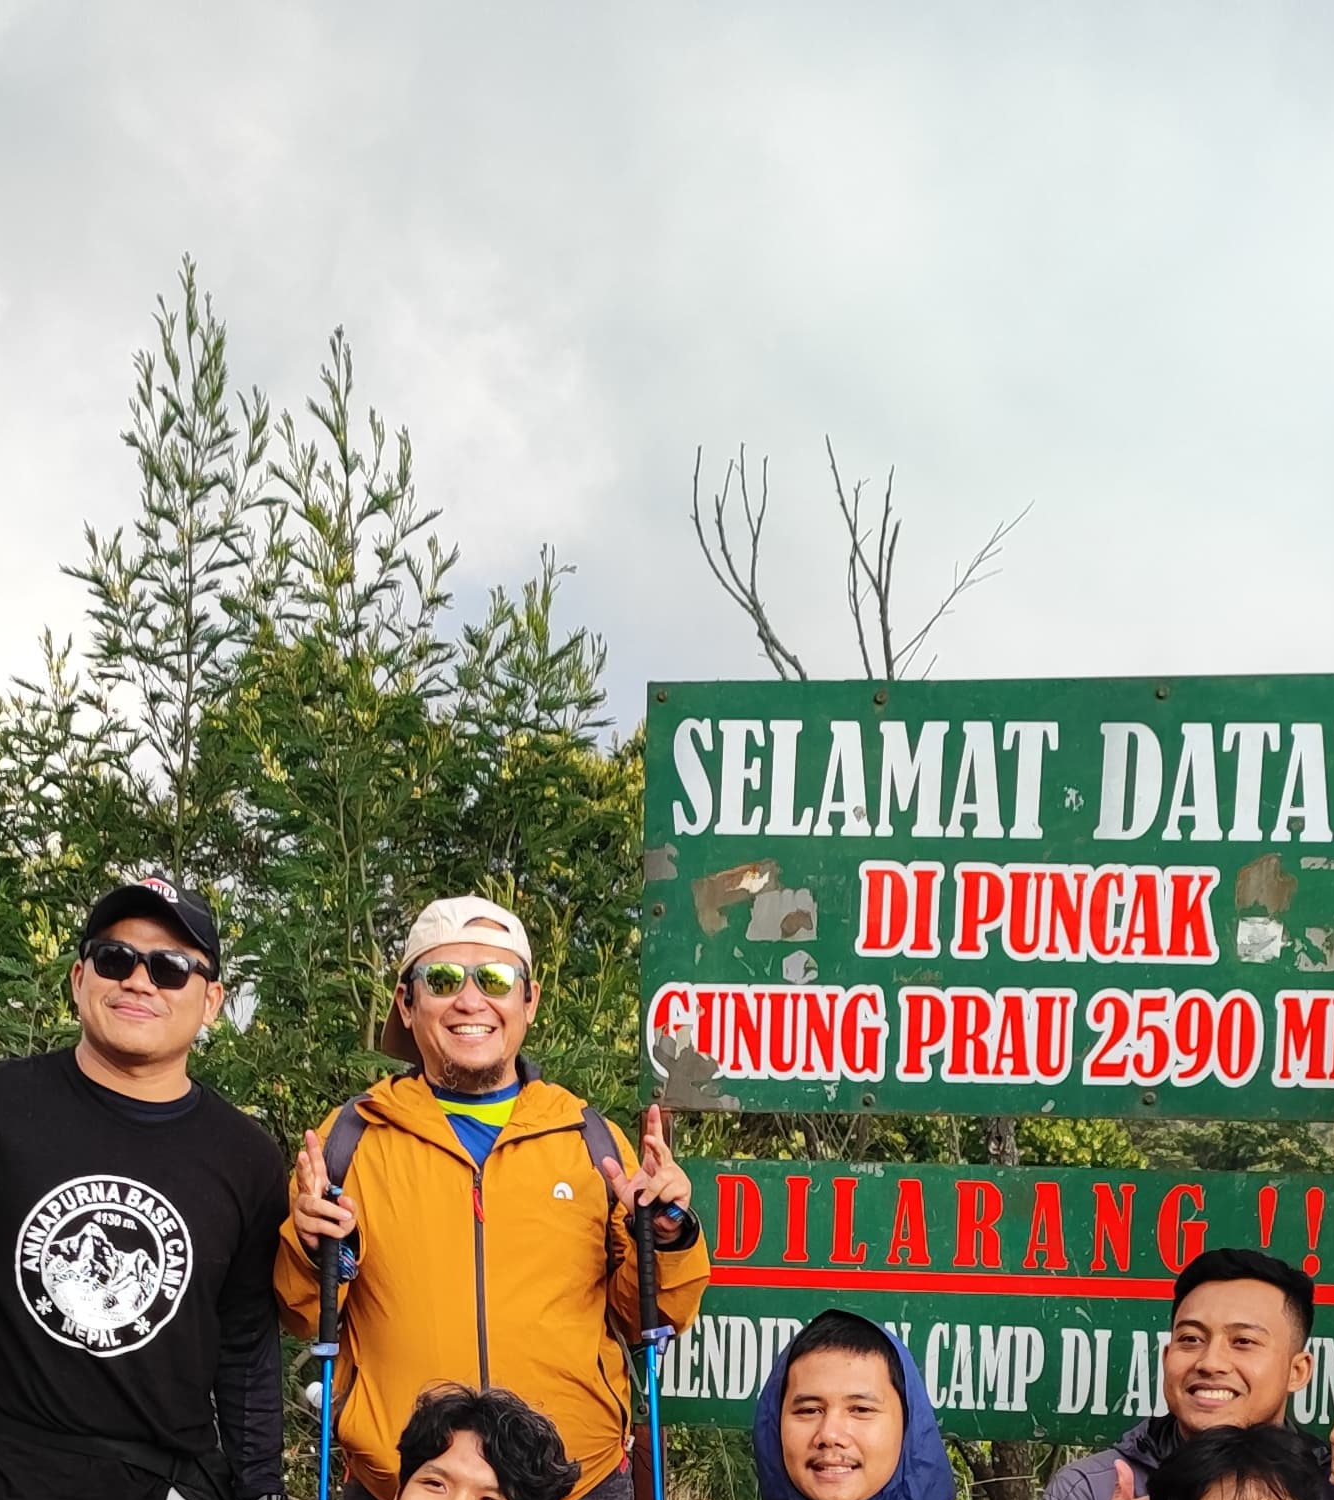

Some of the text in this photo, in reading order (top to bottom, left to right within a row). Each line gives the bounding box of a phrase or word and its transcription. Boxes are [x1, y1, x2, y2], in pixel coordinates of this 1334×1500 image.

[672, 718, 1059, 840] SELAMAT
[859, 867, 1217, 959] DI PUNCAK
[900, 992, 1072, 1079] PRAU
[1088, 994, 1259, 1082] 2590
[22, 1182, 185, 1300] ANNAPURNA BASE CAMP
[713, 1173, 1209, 1274] DILARANG
[61, 1318, 121, 1347] NEPAL
[925, 1322, 1045, 1411] CAMP
[1056, 1328, 1112, 1416] DI
